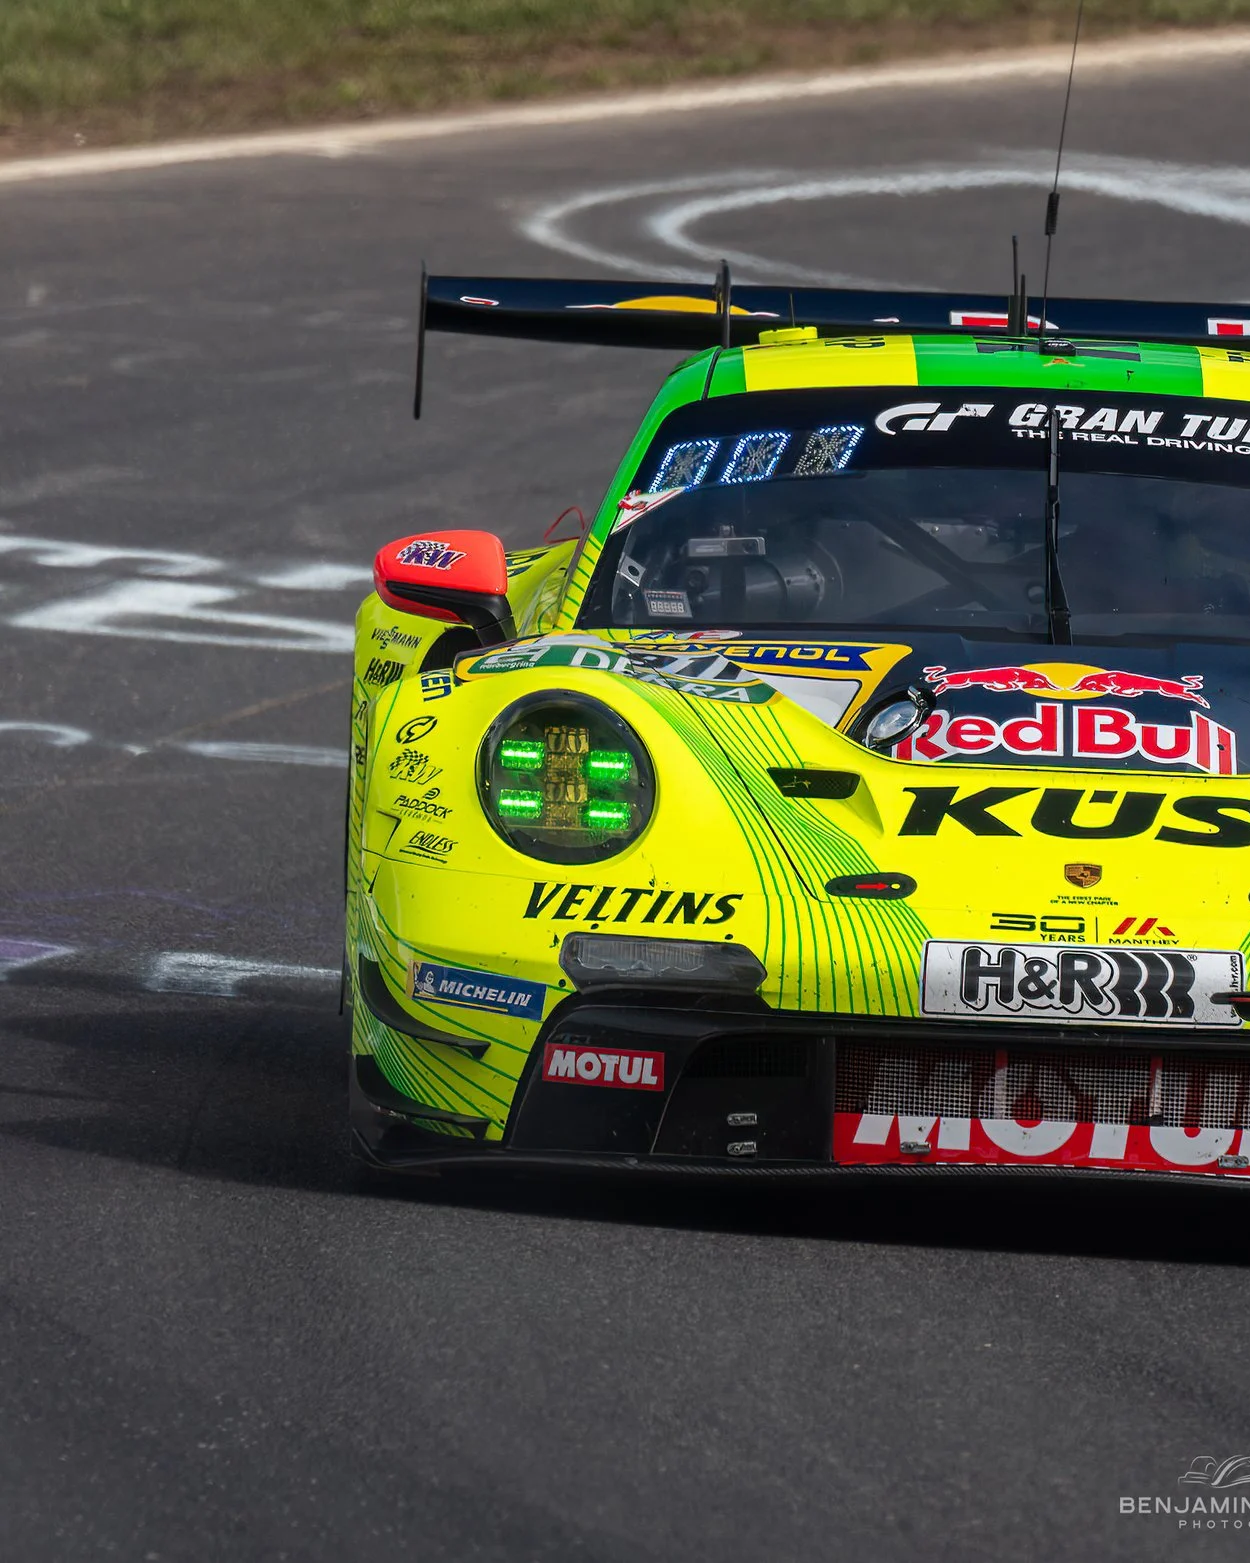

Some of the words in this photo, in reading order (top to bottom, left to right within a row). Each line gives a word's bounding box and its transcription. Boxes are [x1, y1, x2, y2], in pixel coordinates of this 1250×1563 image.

[1008, 403, 1164, 435] GRAN
[1072, 431, 1138, 445] REAL
[892, 702, 1064, 762] Red
[1072, 705, 1237, 775] Bull
[394, 795, 453, 819] PADDOCK
[409, 831, 458, 853] ENDLESS
[523, 881, 743, 925] VELTINS
[990, 912, 1085, 933] 30
[1040, 934, 1086, 943] YEARS
[438, 979, 532, 1007] MICHELIN
[961, 946, 1116, 1017] H&R
[547, 1050, 658, 1085] MOTUL
